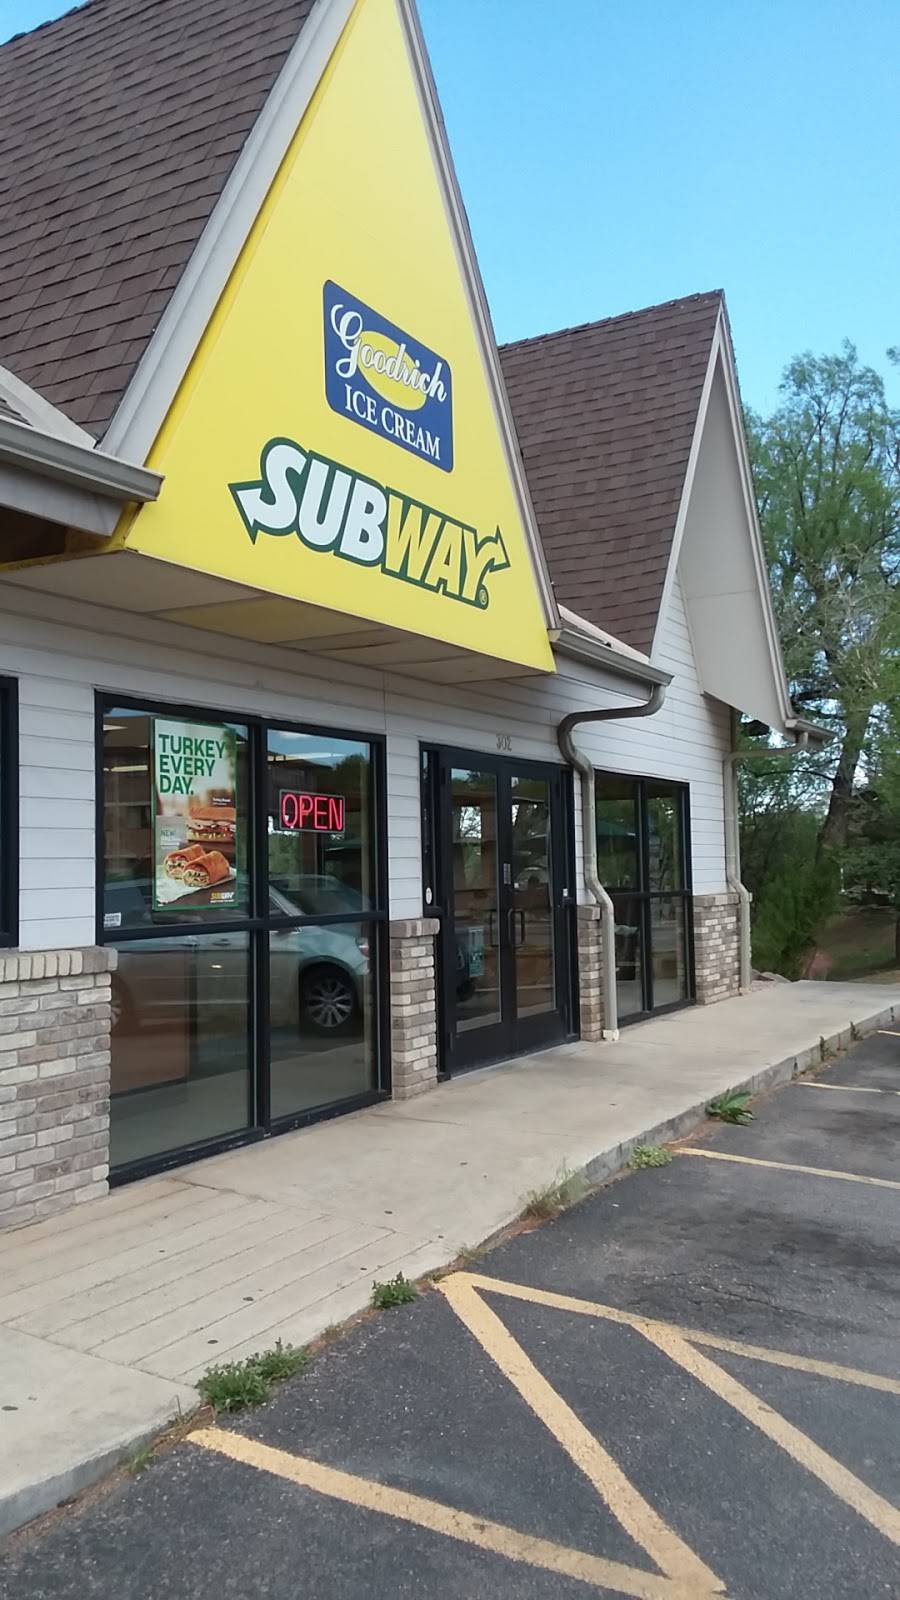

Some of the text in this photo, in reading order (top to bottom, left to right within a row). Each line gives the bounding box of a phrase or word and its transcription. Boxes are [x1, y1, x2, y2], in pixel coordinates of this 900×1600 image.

[331, 304, 448, 402] Goodrich
[344, 383, 441, 461] ICE CREAM
[234, 441, 507, 606] SUBWAY
[158, 733, 226, 759] TURKEY
[160, 754, 216, 777] EVERY
[160, 774, 194, 796] DAY.
[282, 793, 343, 831] OPEN
